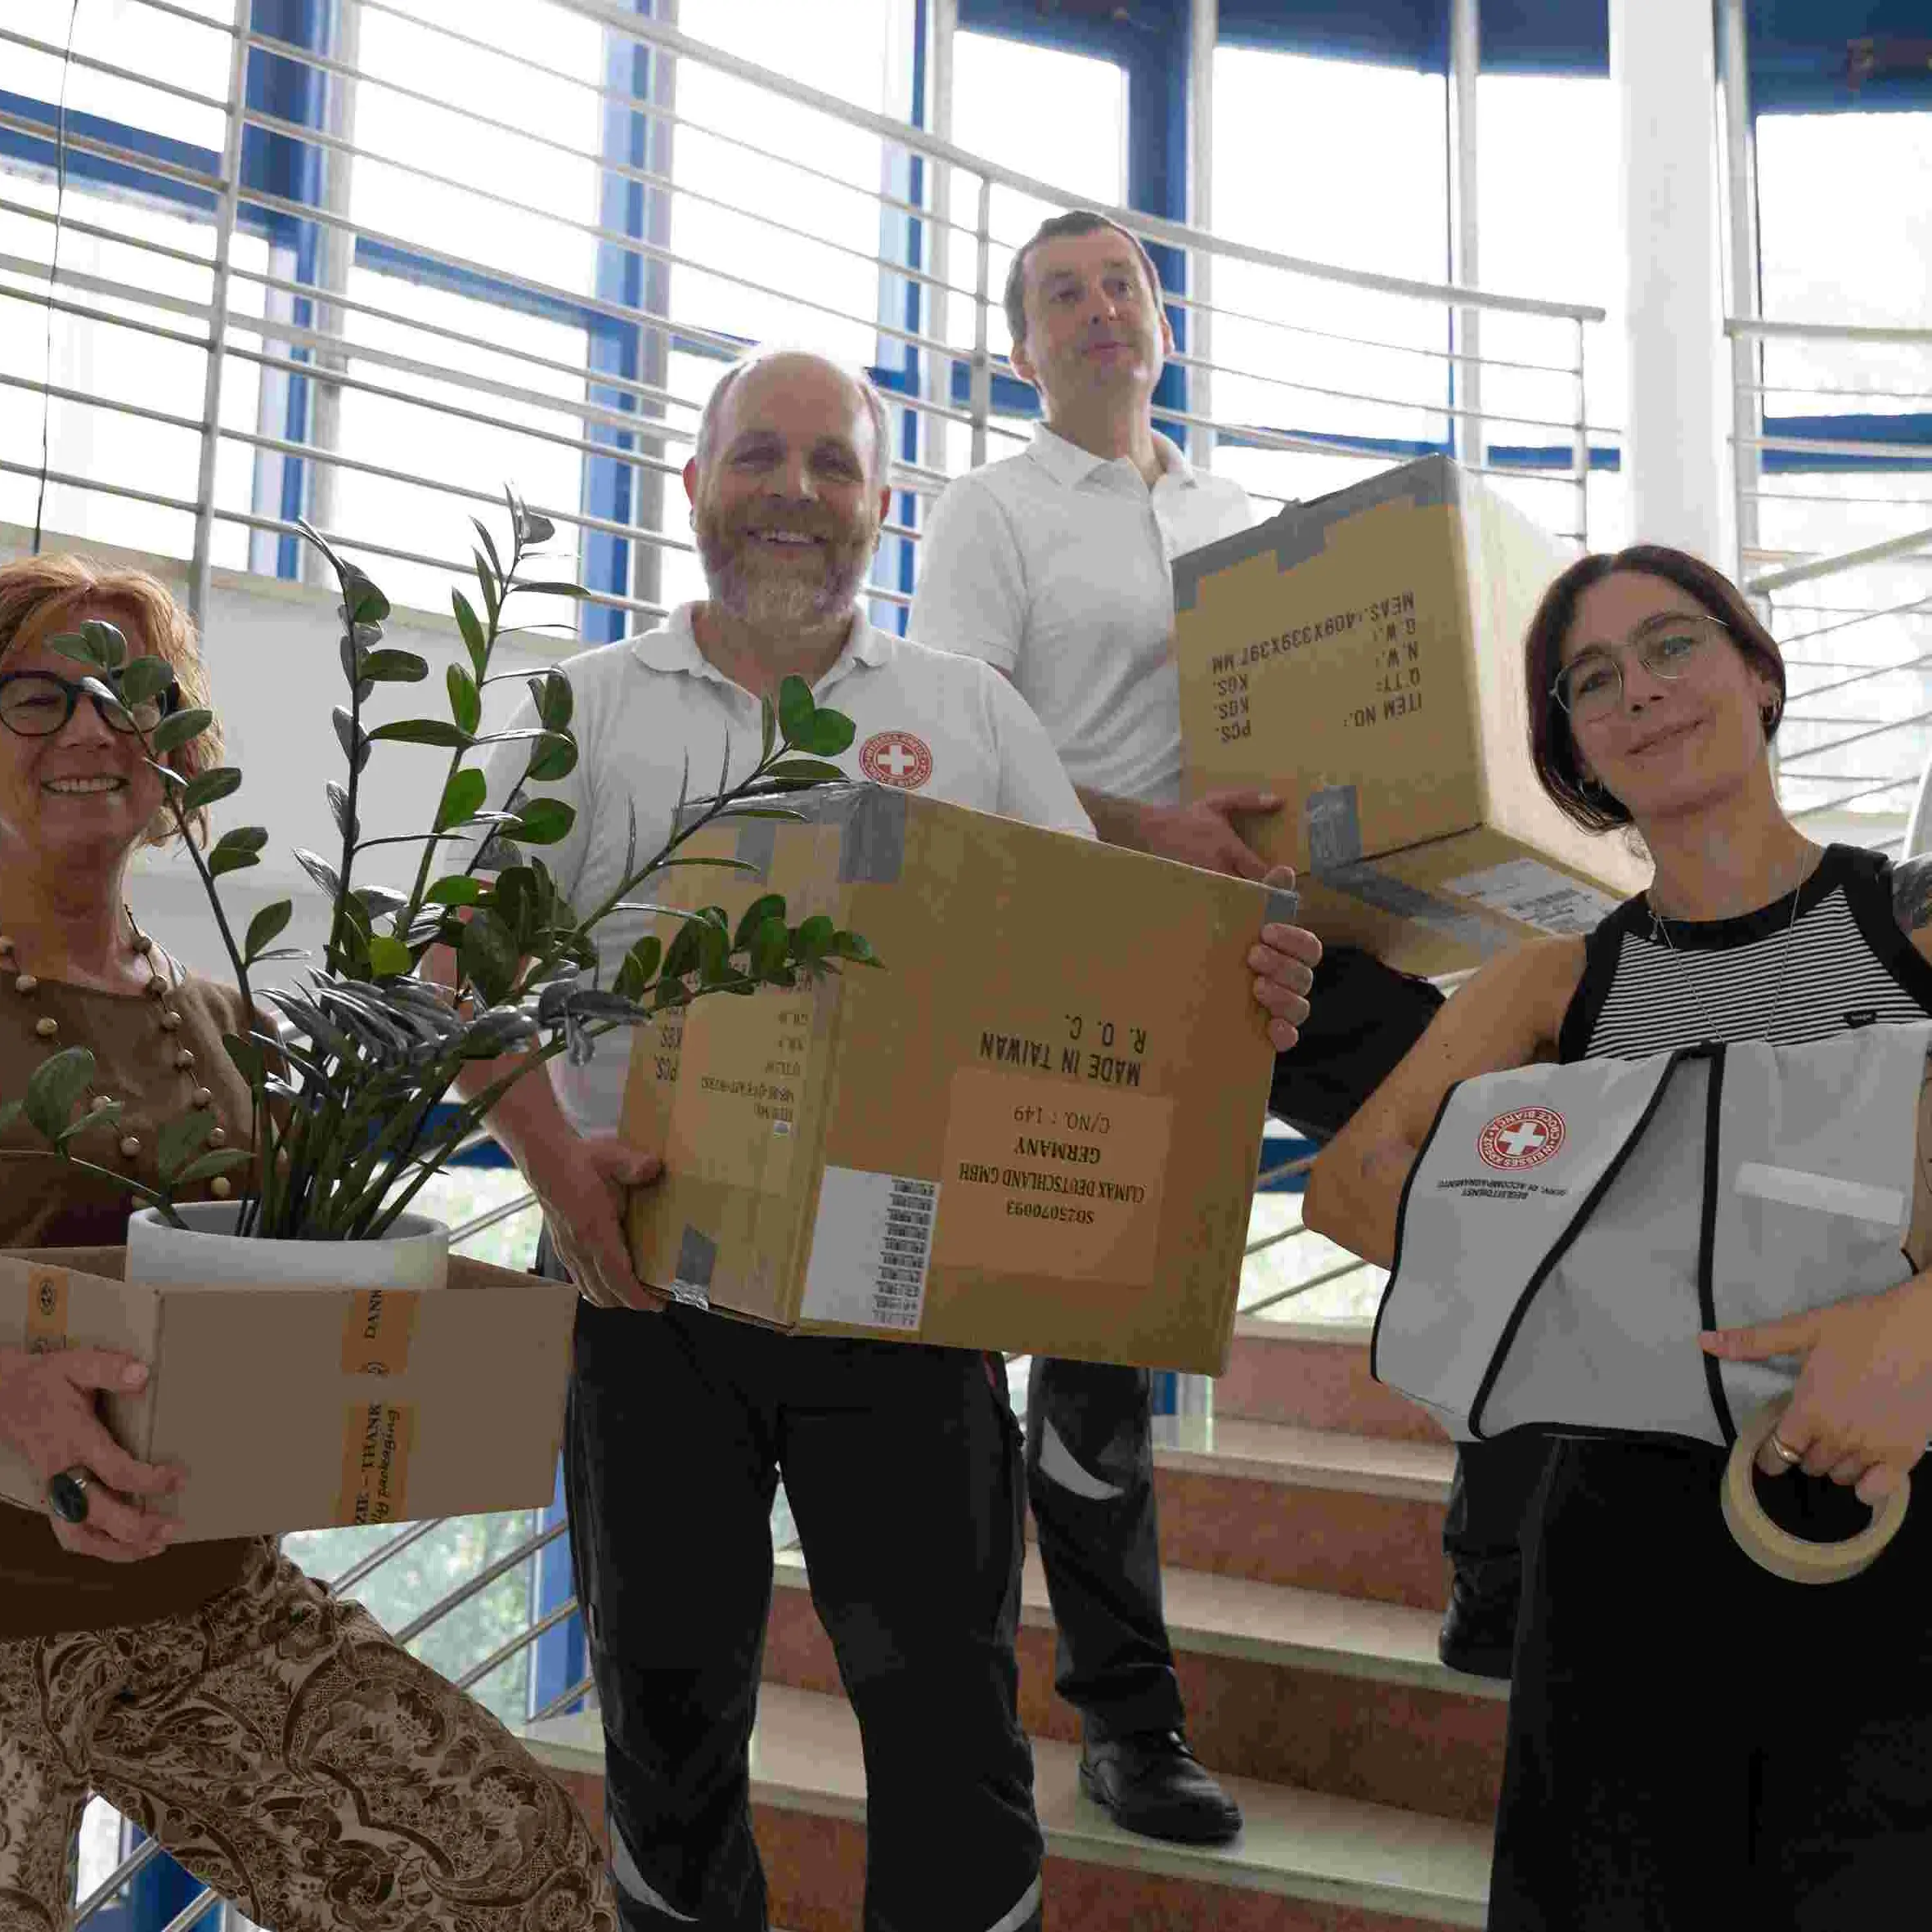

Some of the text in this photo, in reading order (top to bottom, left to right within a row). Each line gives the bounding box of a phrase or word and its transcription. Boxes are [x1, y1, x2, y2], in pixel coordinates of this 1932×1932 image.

[1212, 654, 1234, 673] MM
[1212, 674, 1248, 695] KGS.
[1213, 697, 1249, 720] KGS.
[1383, 693, 1422, 720] ITEM
[1215, 720, 1251, 741] PCS.
[1064, 1014, 1146, 1054] R. O. C.
[979, 1032, 1141, 1086] MADE IN TAIWAN
[1013, 1106, 1043, 1124] 149
[1538, 1112, 1560, 1139] CROCE
[1013, 1137, 1101, 1165] GERMANY
[1504, 1145, 1554, 1166] WEISSES
[958, 1163, 1145, 1203] CLIMAX DEUTSCHLAND GMBH
[1004, 1200, 1095, 1224] SO25070093
[360, 1404, 382, 1472] THANK
[376, 1409, 400, 1498] packaging
